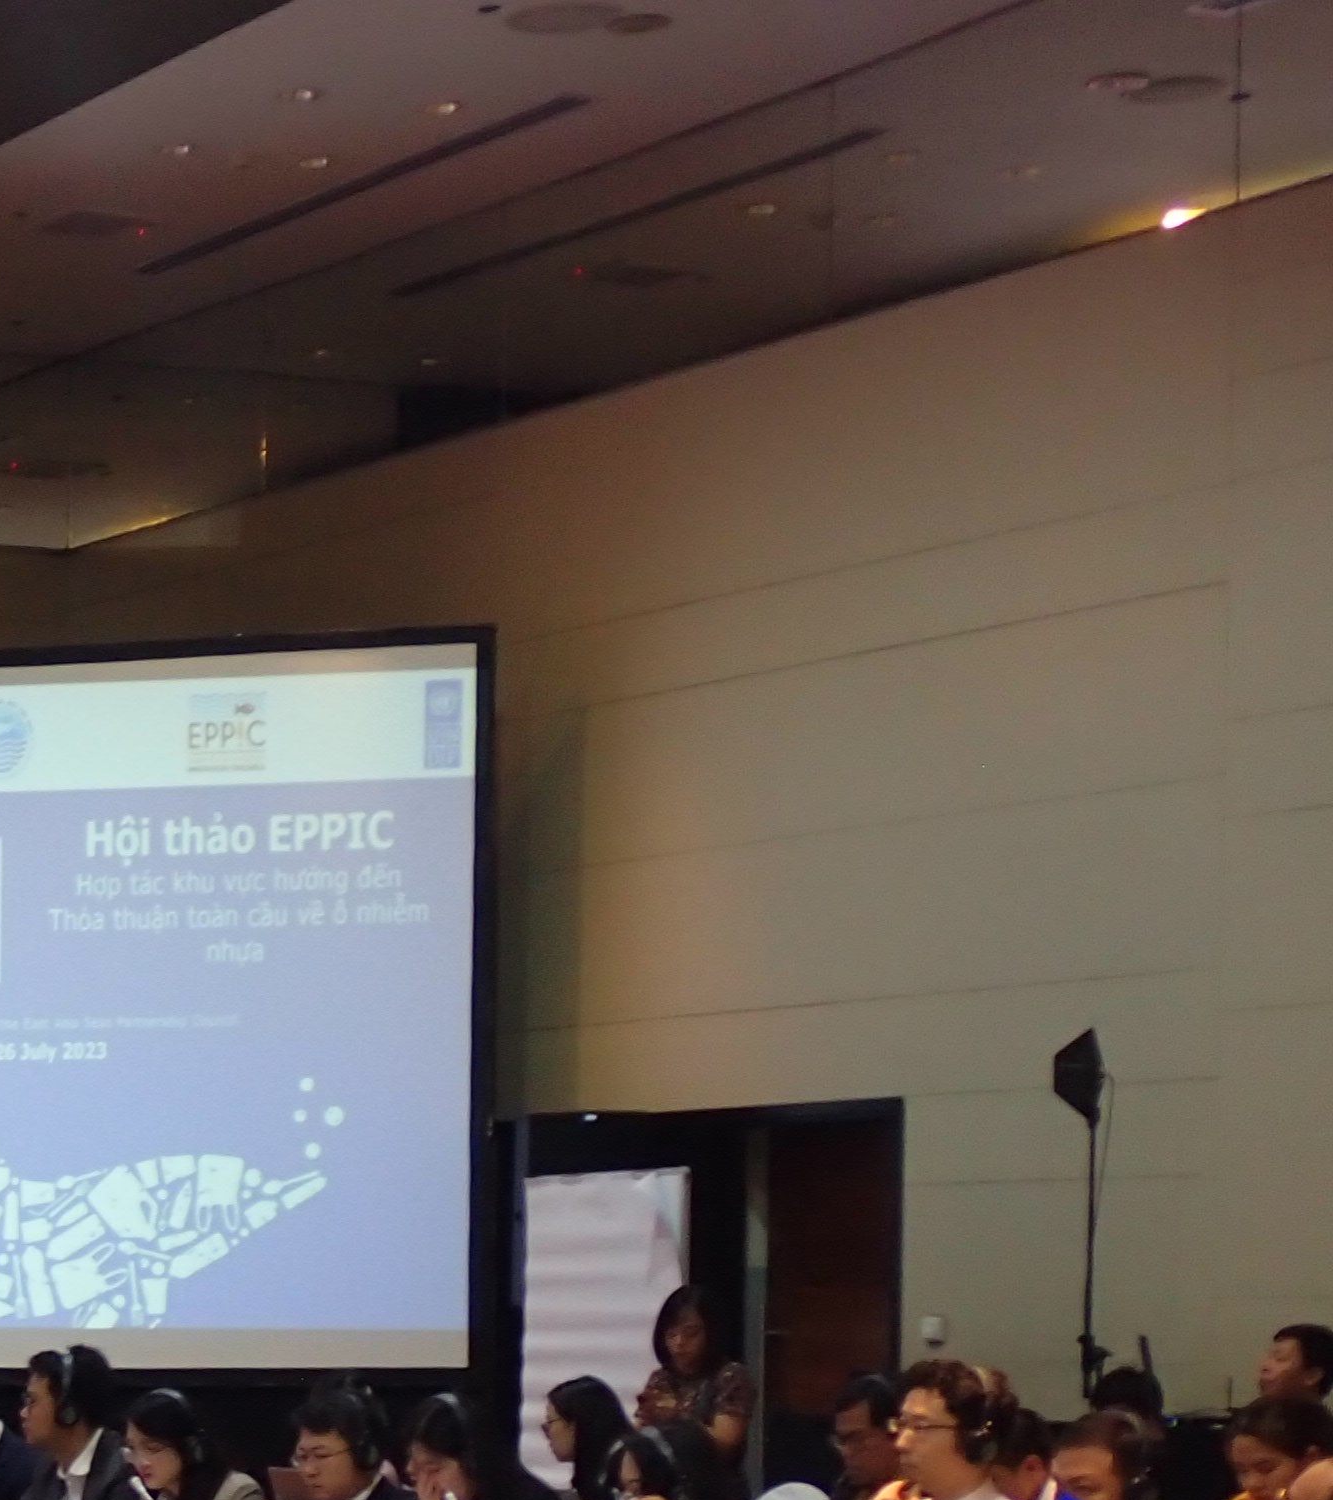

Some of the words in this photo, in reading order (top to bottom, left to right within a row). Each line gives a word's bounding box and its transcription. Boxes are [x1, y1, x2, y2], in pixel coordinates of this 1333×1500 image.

[85, 813, 151, 867] Hội
[164, 811, 256, 857] thảo
[269, 810, 395, 852] EPPIC
[76, 871, 122, 900] Hợp
[130, 869, 164, 895] tác
[173, 868, 215, 893] khu
[224, 871, 265, 896] vực
[274, 865, 349, 894] hướng
[358, 862, 403, 889] đến
[114, 904, 179, 932] thuận
[188, 902, 238, 929] toàn
[357, 892, 430, 924] nhiễm
[20, 1042, 57, 1064] July
[63, 1042, 107, 1061] 2023
